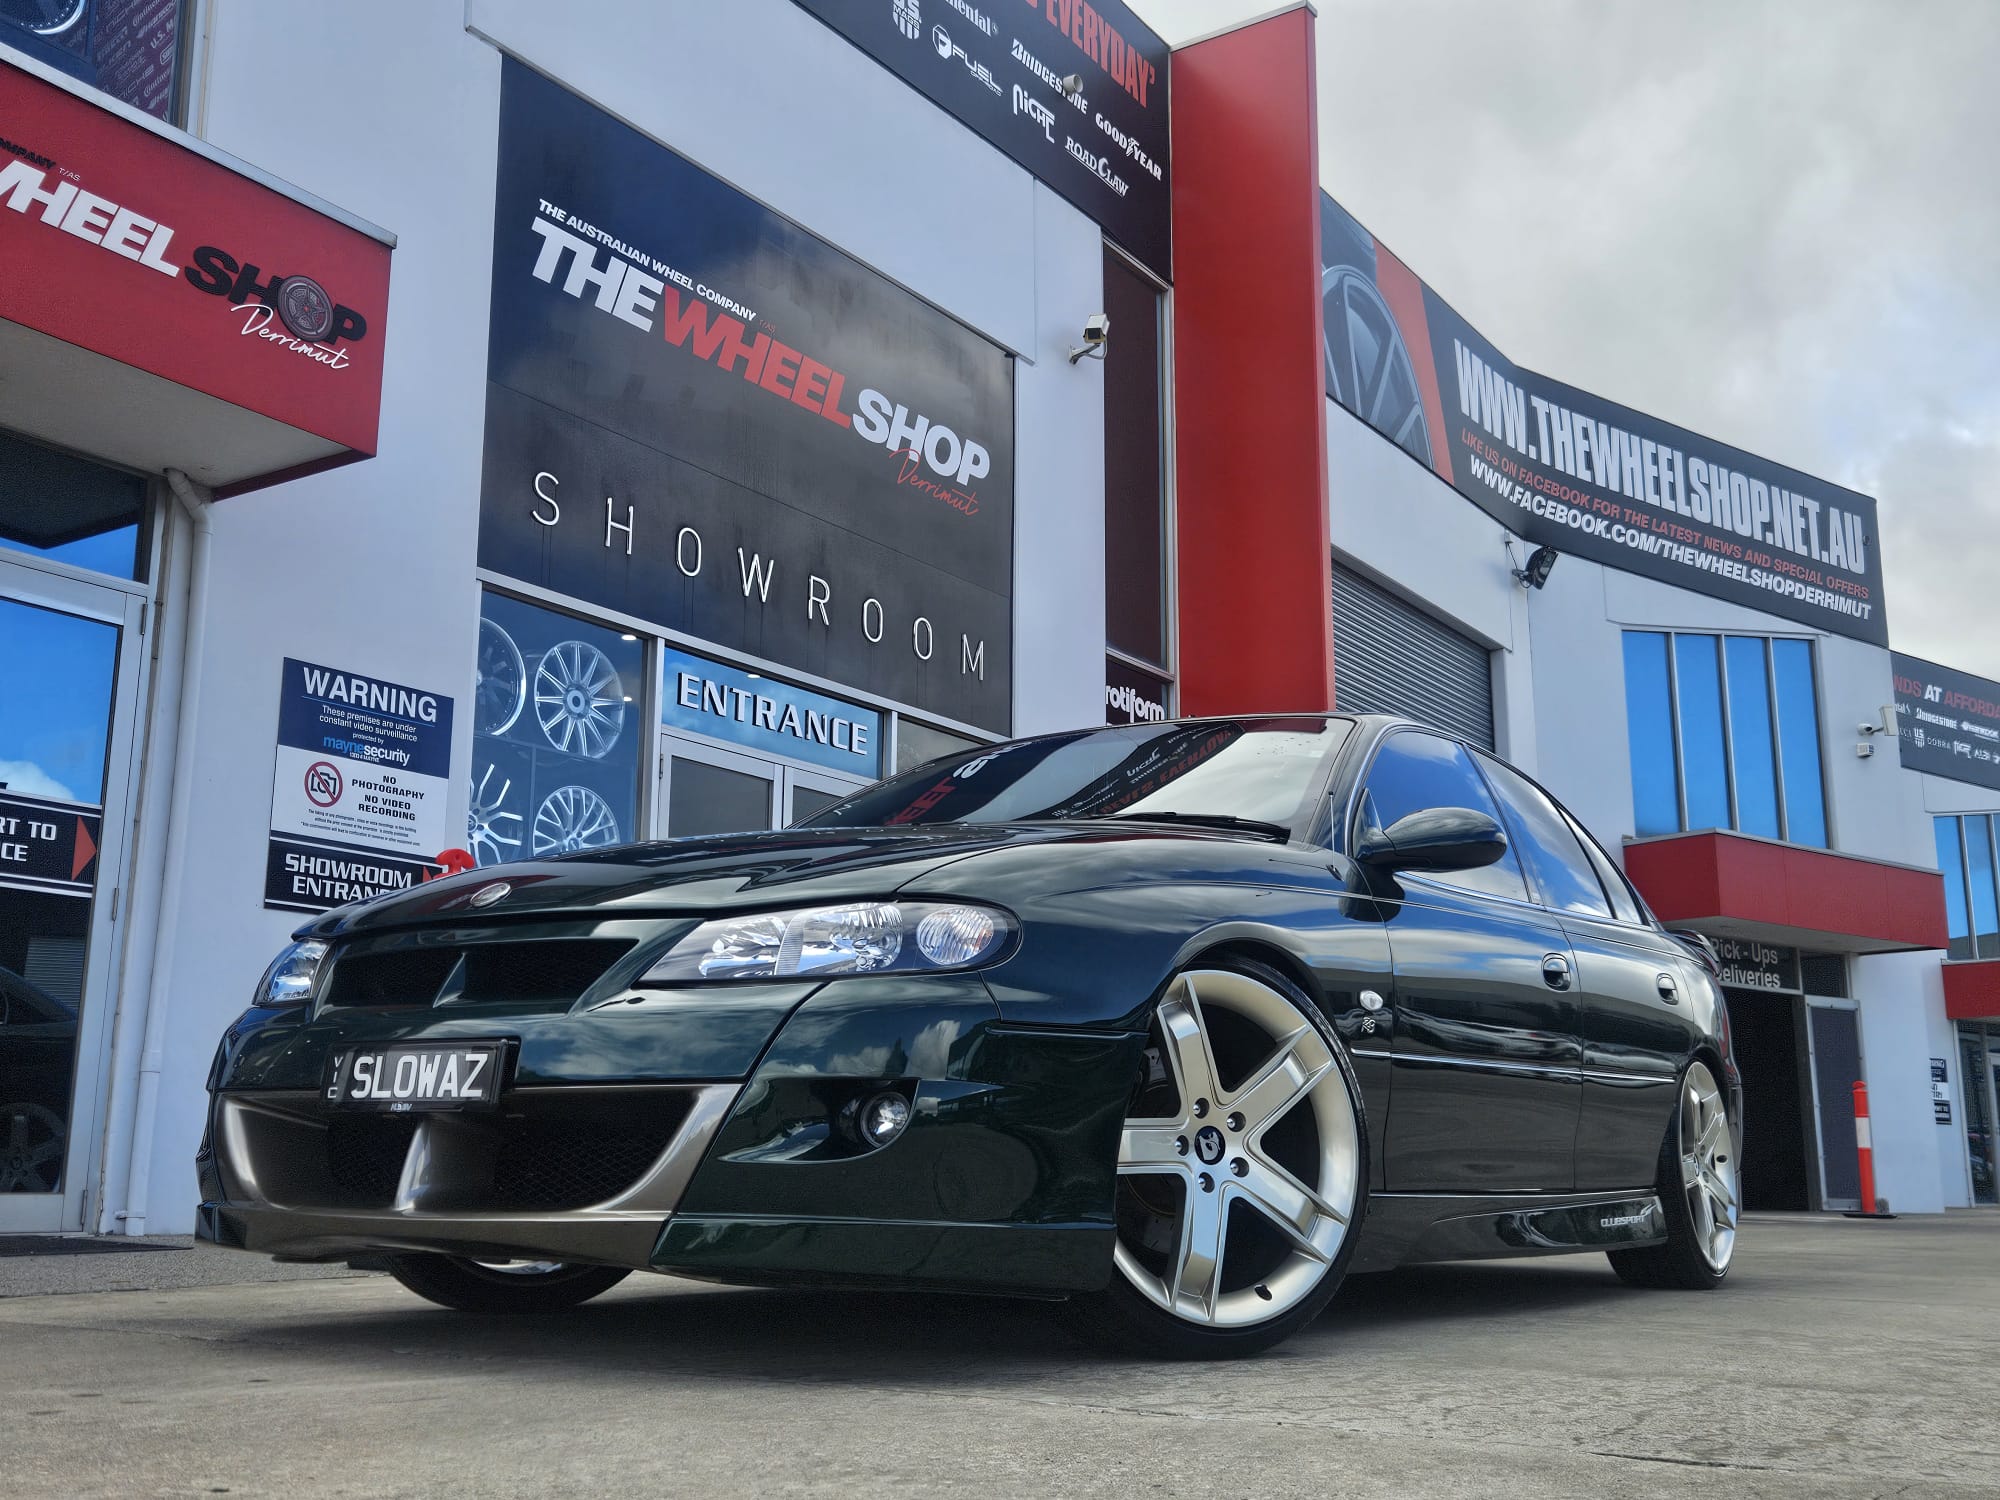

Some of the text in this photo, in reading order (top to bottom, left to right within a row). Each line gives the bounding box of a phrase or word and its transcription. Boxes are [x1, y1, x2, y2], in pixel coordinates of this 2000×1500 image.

[952, 44, 1003, 93] FUEL
[1095, 112, 1162, 181] GOODYEAR
[539, 198, 567, 222] THE
[566, 215, 650, 267] AUSTRALIAN
[652, 259, 694, 291] WHEEL
[696, 283, 757, 322] COMPANY
[231, 304, 349, 369] Derrimut
[1454, 338, 1865, 575] WWW.THEWHEELSHOP.NET.AU
[889, 448, 979, 516] Derrimut
[1461, 427, 1869, 599] LIKE US ON FACEBOOK FOR THE LATEST NEWS AND SPECIAL OFFERS
[1471, 454, 1871, 620] WWW.FACEBOOK.COM/THEWHEELSHOPDERRIMUT
[532, 471, 986, 681] SHOWROOM
[303, 666, 437, 723] WARNING
[677, 671, 868, 756] ENTRANCE
[1105, 685, 1165, 723] rotiform
[1924, 684, 1942, 703] AT
[319, 714, 418, 743] constant video surveillance
[322, 705, 416, 734] These premises are under
[352, 733, 384, 745] protected by
[351, 778, 425, 800] PHOTOGRAPHY
[382, 775, 397, 785] NO
[358, 803, 416, 821] RECORDING
[364, 794, 411, 810] NO VIDEO
[28, 821, 57, 841] TO
[285, 853, 412, 889] SHOWROOM
[1716, 963, 1780, 989] eliveries
[351, 1053, 488, 1099] SLOWAZ
